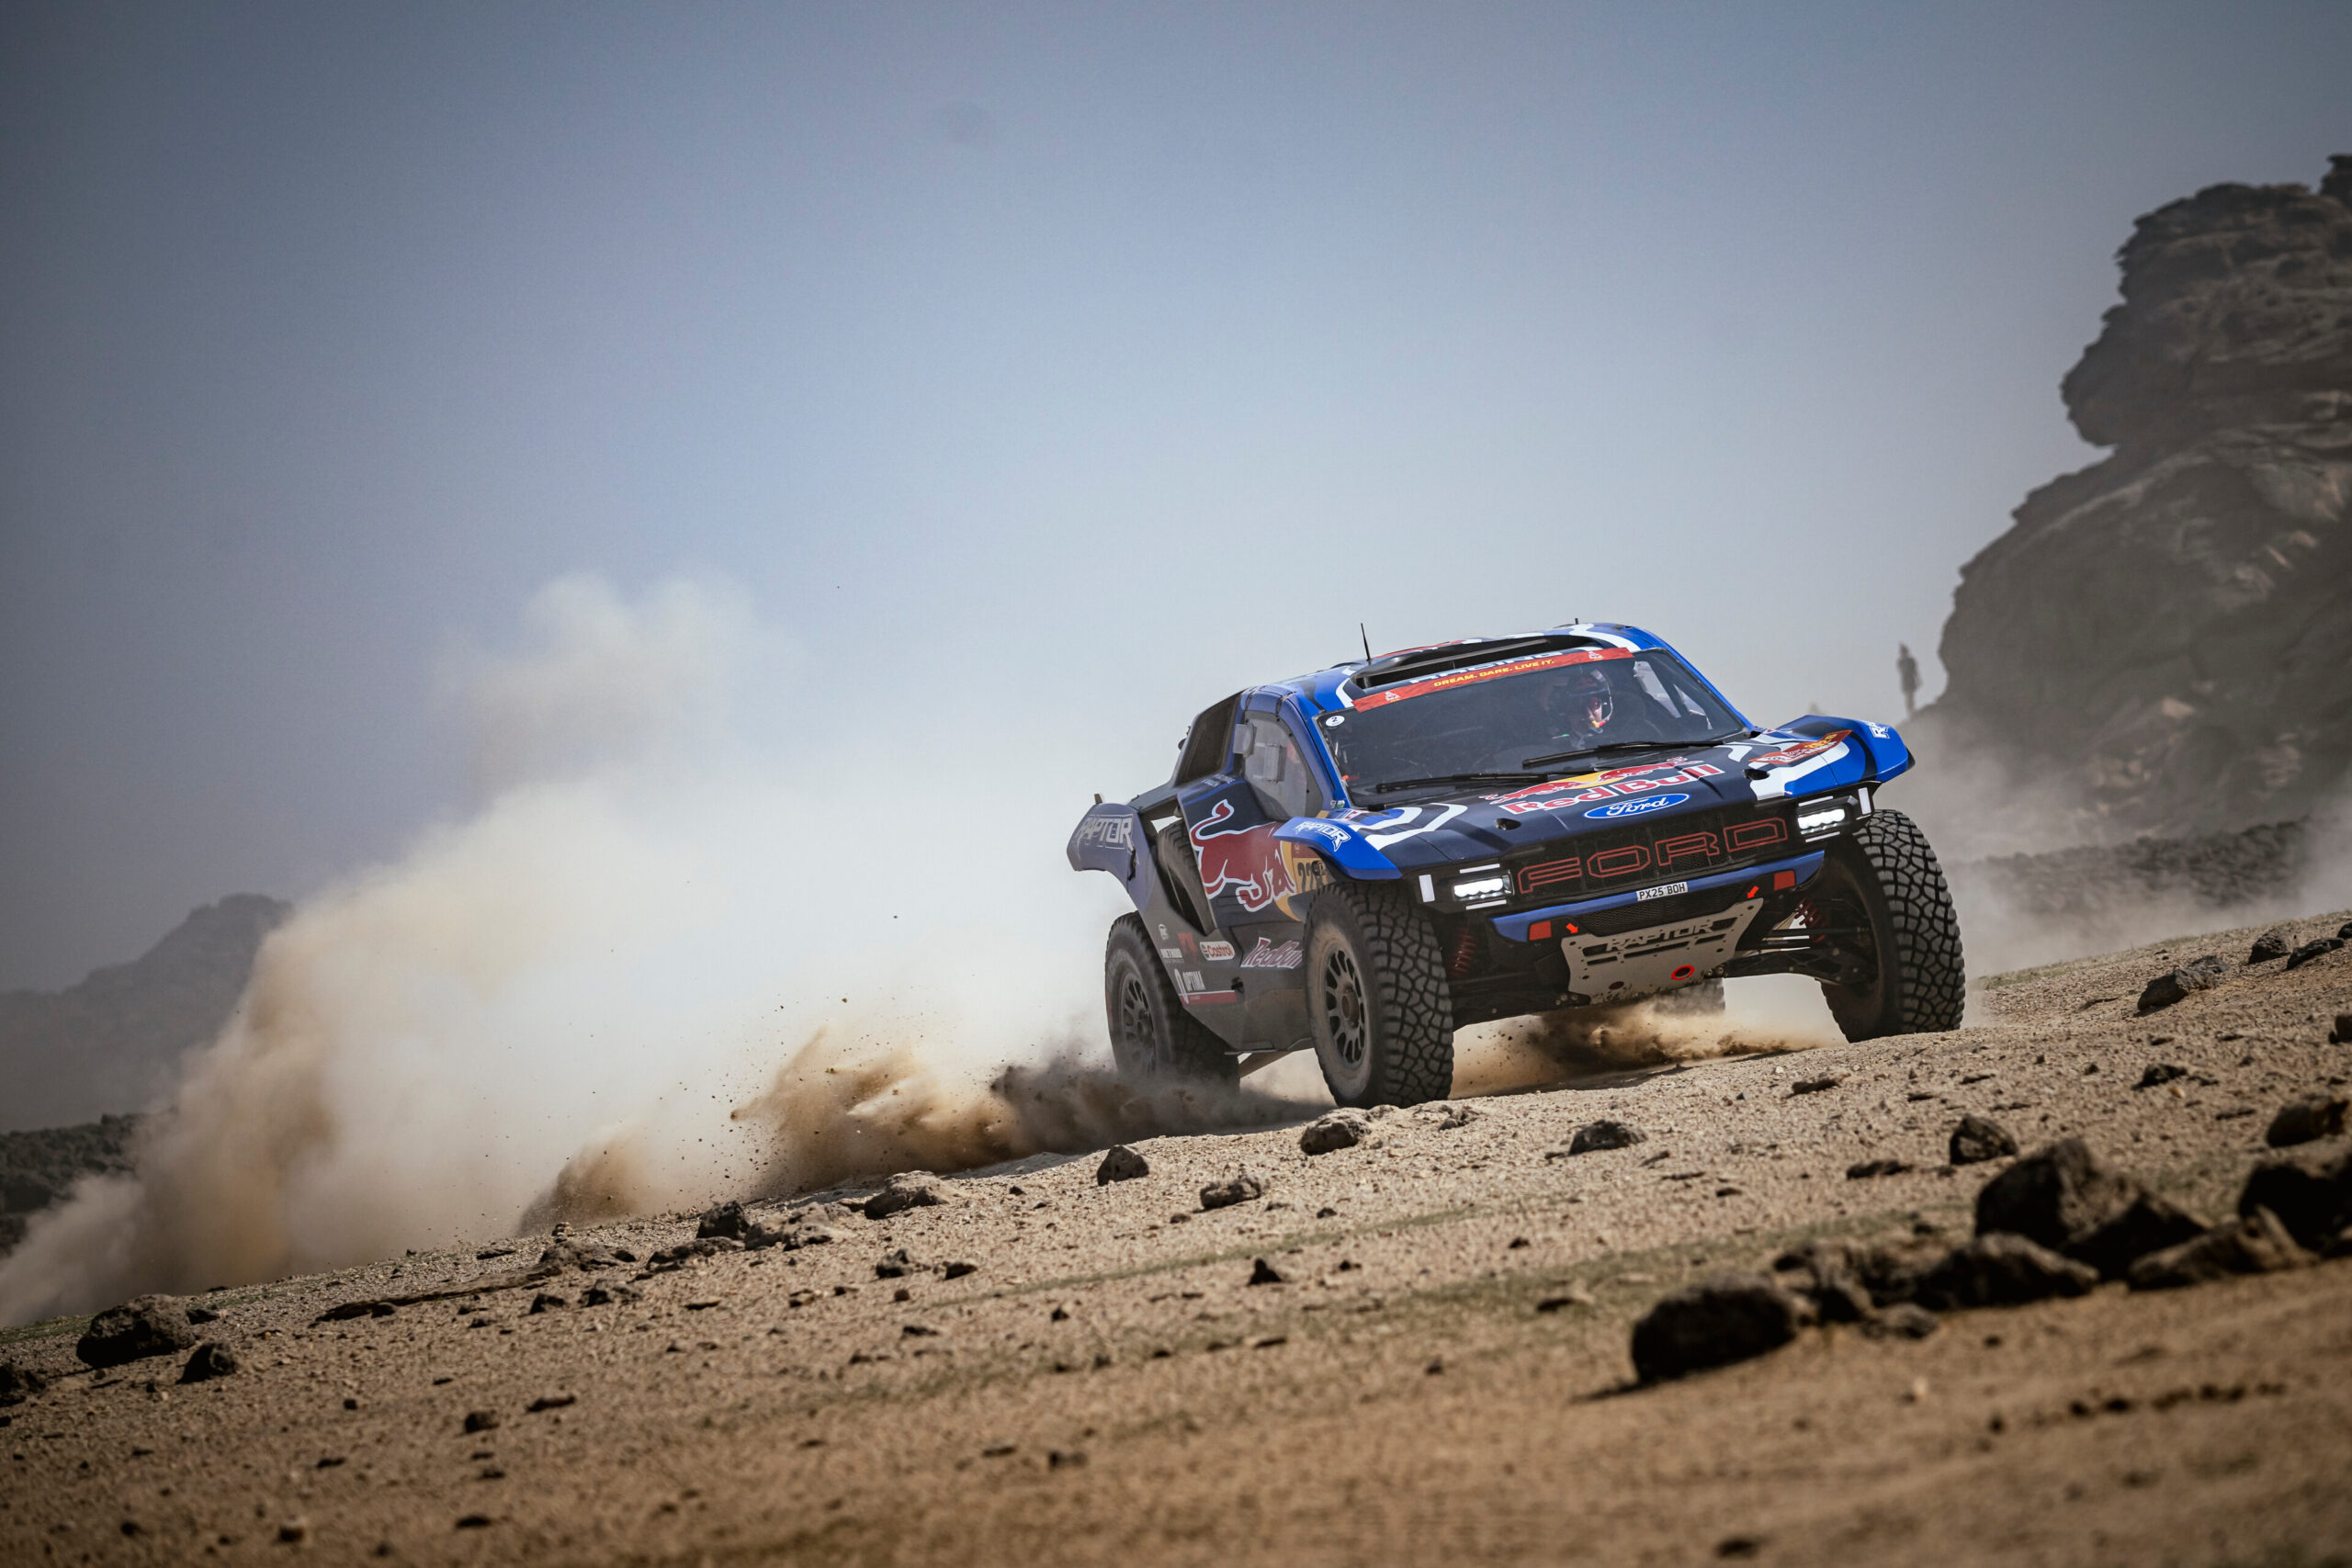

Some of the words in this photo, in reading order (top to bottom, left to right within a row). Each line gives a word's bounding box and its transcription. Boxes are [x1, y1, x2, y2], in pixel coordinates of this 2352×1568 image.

[1433, 674, 1477, 687] DREAM.
[1479, 667, 1513, 677] DARE.
[1514, 660, 1539, 671] LIVE
[1498, 785, 1620, 815] Red
[1611, 764, 1725, 795] Bull
[1606, 796, 1669, 817] Ford
[1073, 814, 1134, 854] RAPTOR
[1295, 820, 1351, 852] RAPTOR
[1518, 817, 1788, 894] FORD
[1639, 886, 1664, 899] PX25
[1666, 883, 1686, 895] BOH
[1606, 919, 1714, 951] RAPTOR
[1207, 945, 1234, 959] Castrol
